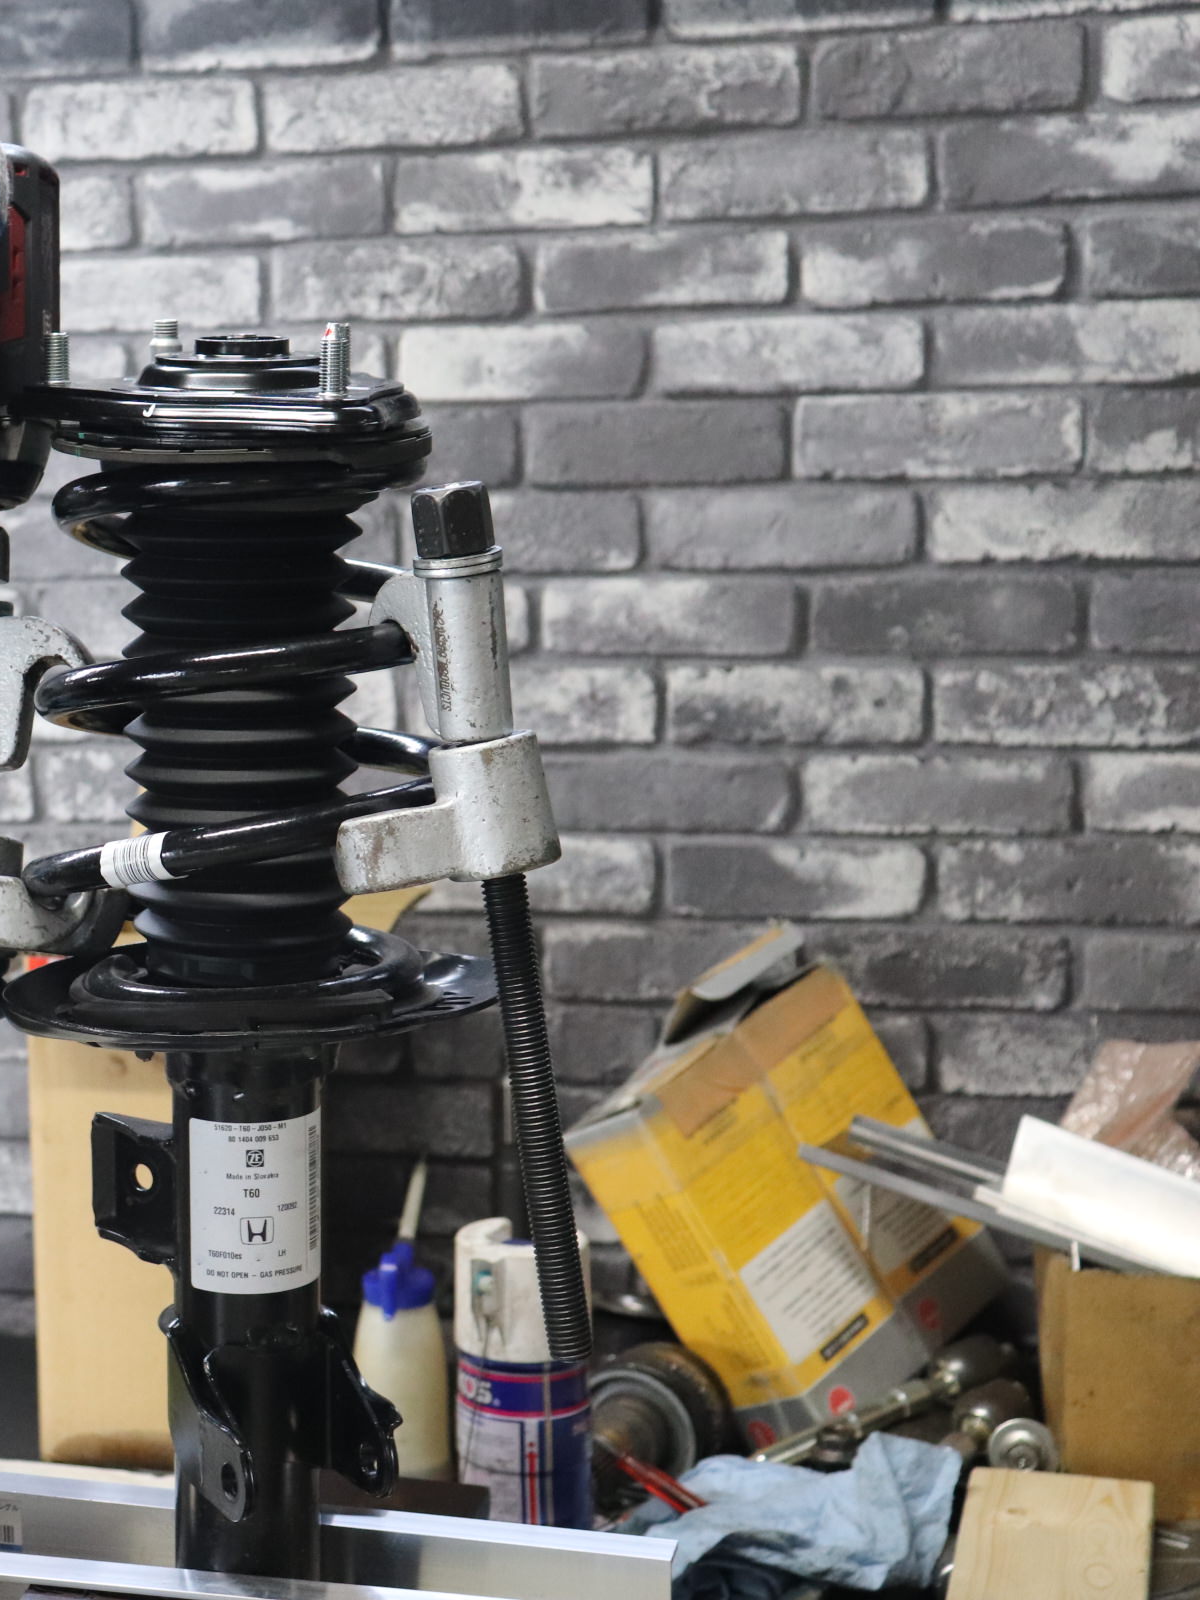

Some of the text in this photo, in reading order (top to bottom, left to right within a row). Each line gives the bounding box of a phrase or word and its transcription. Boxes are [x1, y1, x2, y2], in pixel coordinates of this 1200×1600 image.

[247, 1151, 263, 1165] ZF
[243, 1188, 260, 1198] T60
[213, 1206, 235, 1216] 22314
[206, 1268, 215, 1276] DO
[216, 1270, 229, 1278] NOT
[231, 1271, 249, 1279] OPEN
[259, 1270, 273, 1279] GAS
